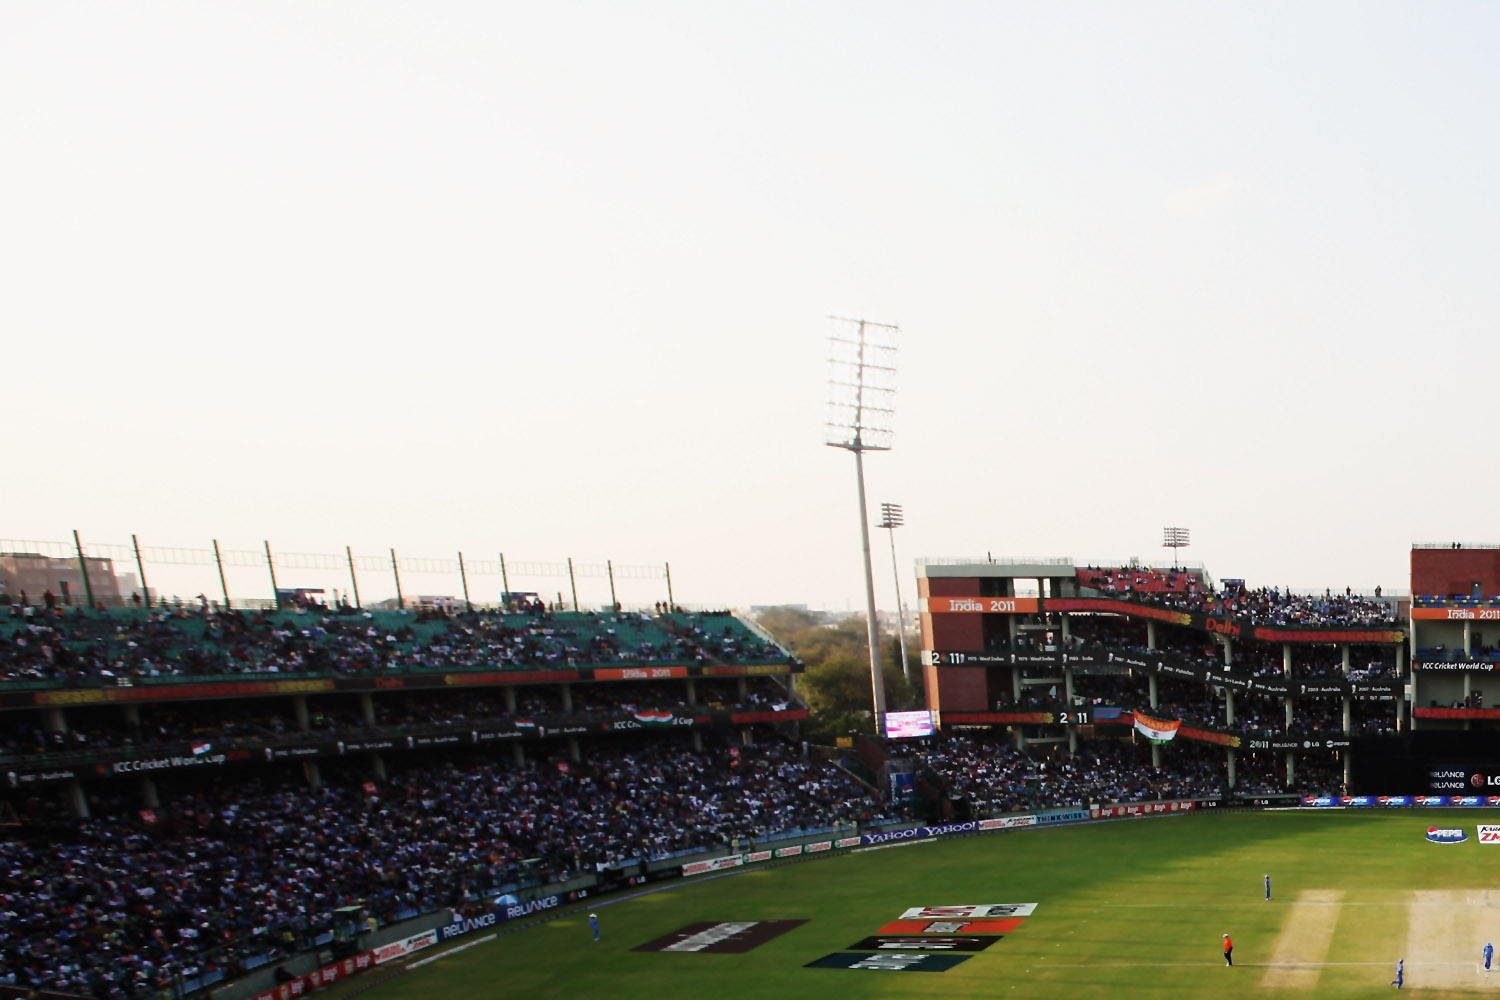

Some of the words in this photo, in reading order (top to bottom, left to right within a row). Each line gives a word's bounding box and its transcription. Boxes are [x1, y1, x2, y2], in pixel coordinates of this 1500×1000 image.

[950, 599, 983, 612] India
[990, 600, 1016, 612] 2011
[1447, 609, 1475, 619] India
[1479, 609, 1500, 619] 2011
[1205, 617, 1241, 636] Delhi
[1422, 662, 1434, 670] ICC
[1434, 662, 1458, 670] Cricket
[1458, 662, 1480, 670] World
[1480, 662, 1494, 671] Cup
[113, 761, 133, 773] ICC
[133, 758, 171, 771] Cricket
[923, 821, 976, 837] YAHOO!
[1436, 828, 1463, 838] PEPSI
[864, 828, 918, 845] YAHOO!
[637, 875, 647, 884] LG
[578, 889, 587, 898] LG
